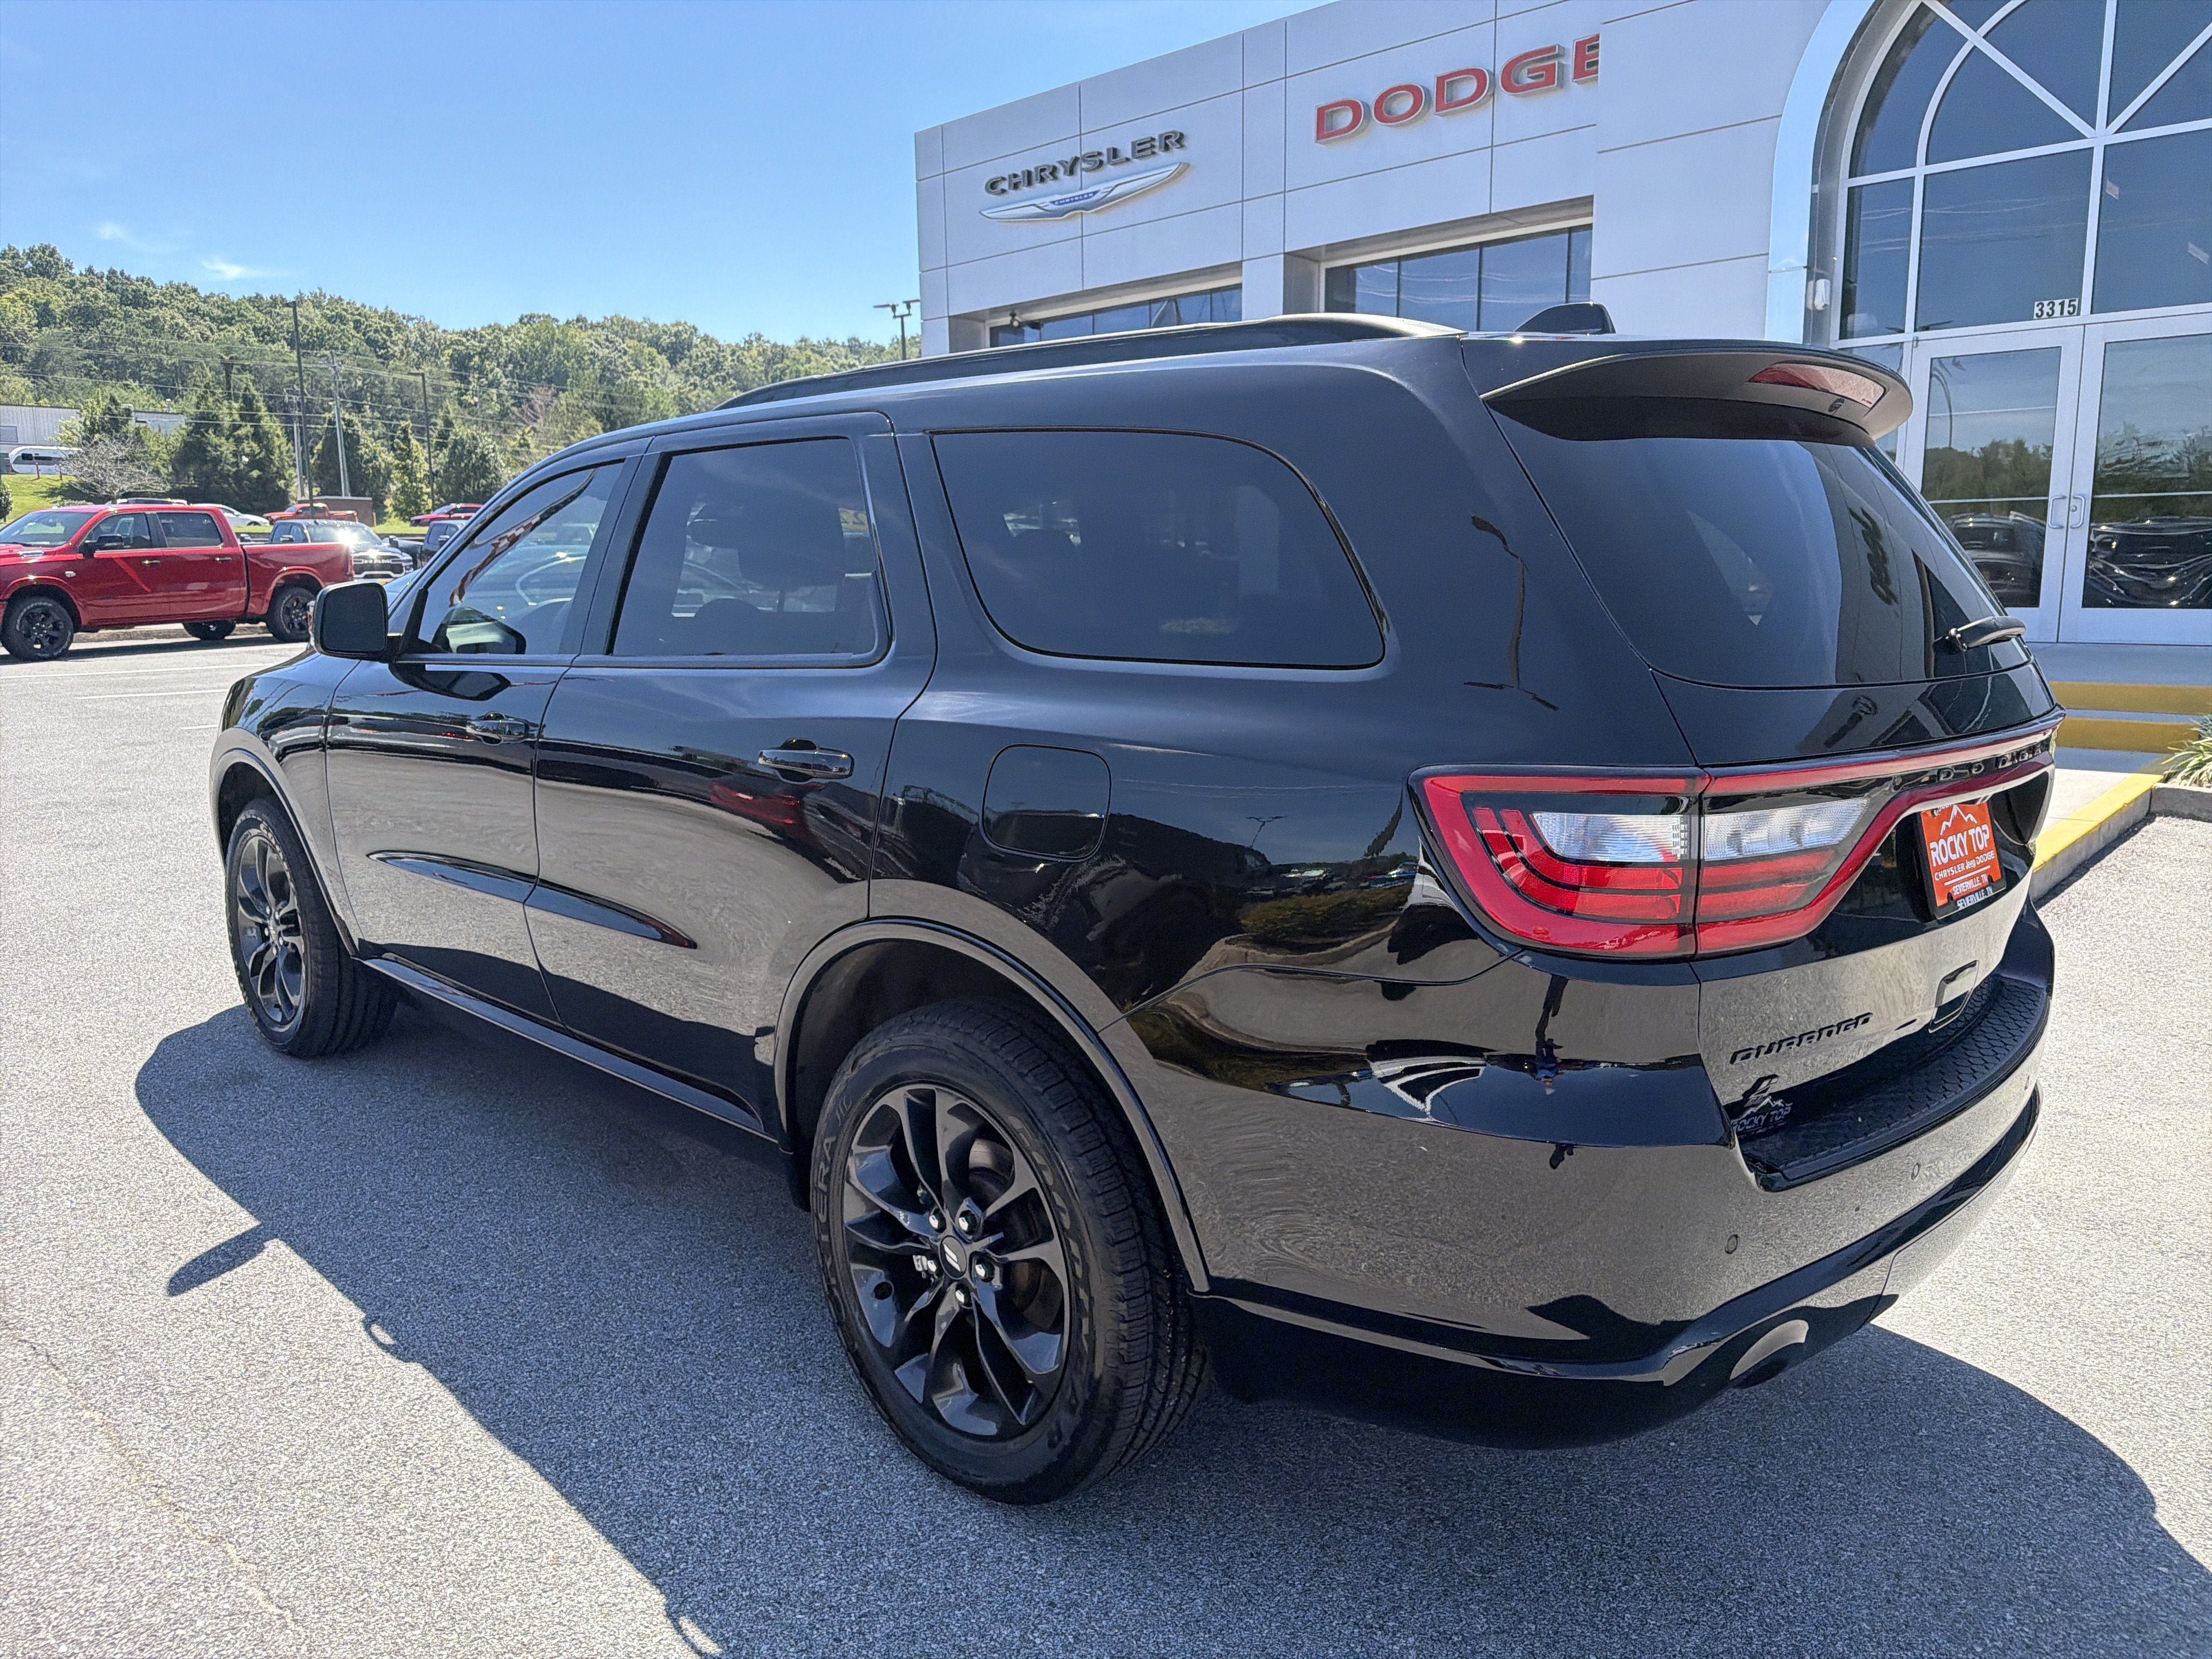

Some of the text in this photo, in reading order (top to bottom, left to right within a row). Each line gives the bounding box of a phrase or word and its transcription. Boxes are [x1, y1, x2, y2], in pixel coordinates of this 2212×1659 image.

[985, 130, 1187, 195] CHRYSLER
[2035, 299, 2076, 318] 3315
[1929, 824, 1990, 867] ROCKY TOP
[1934, 863, 1965, 881] CHRYSLER
[1975, 850, 1995, 865] DODGE
[1730, 1012, 1874, 1065] DURANGO
